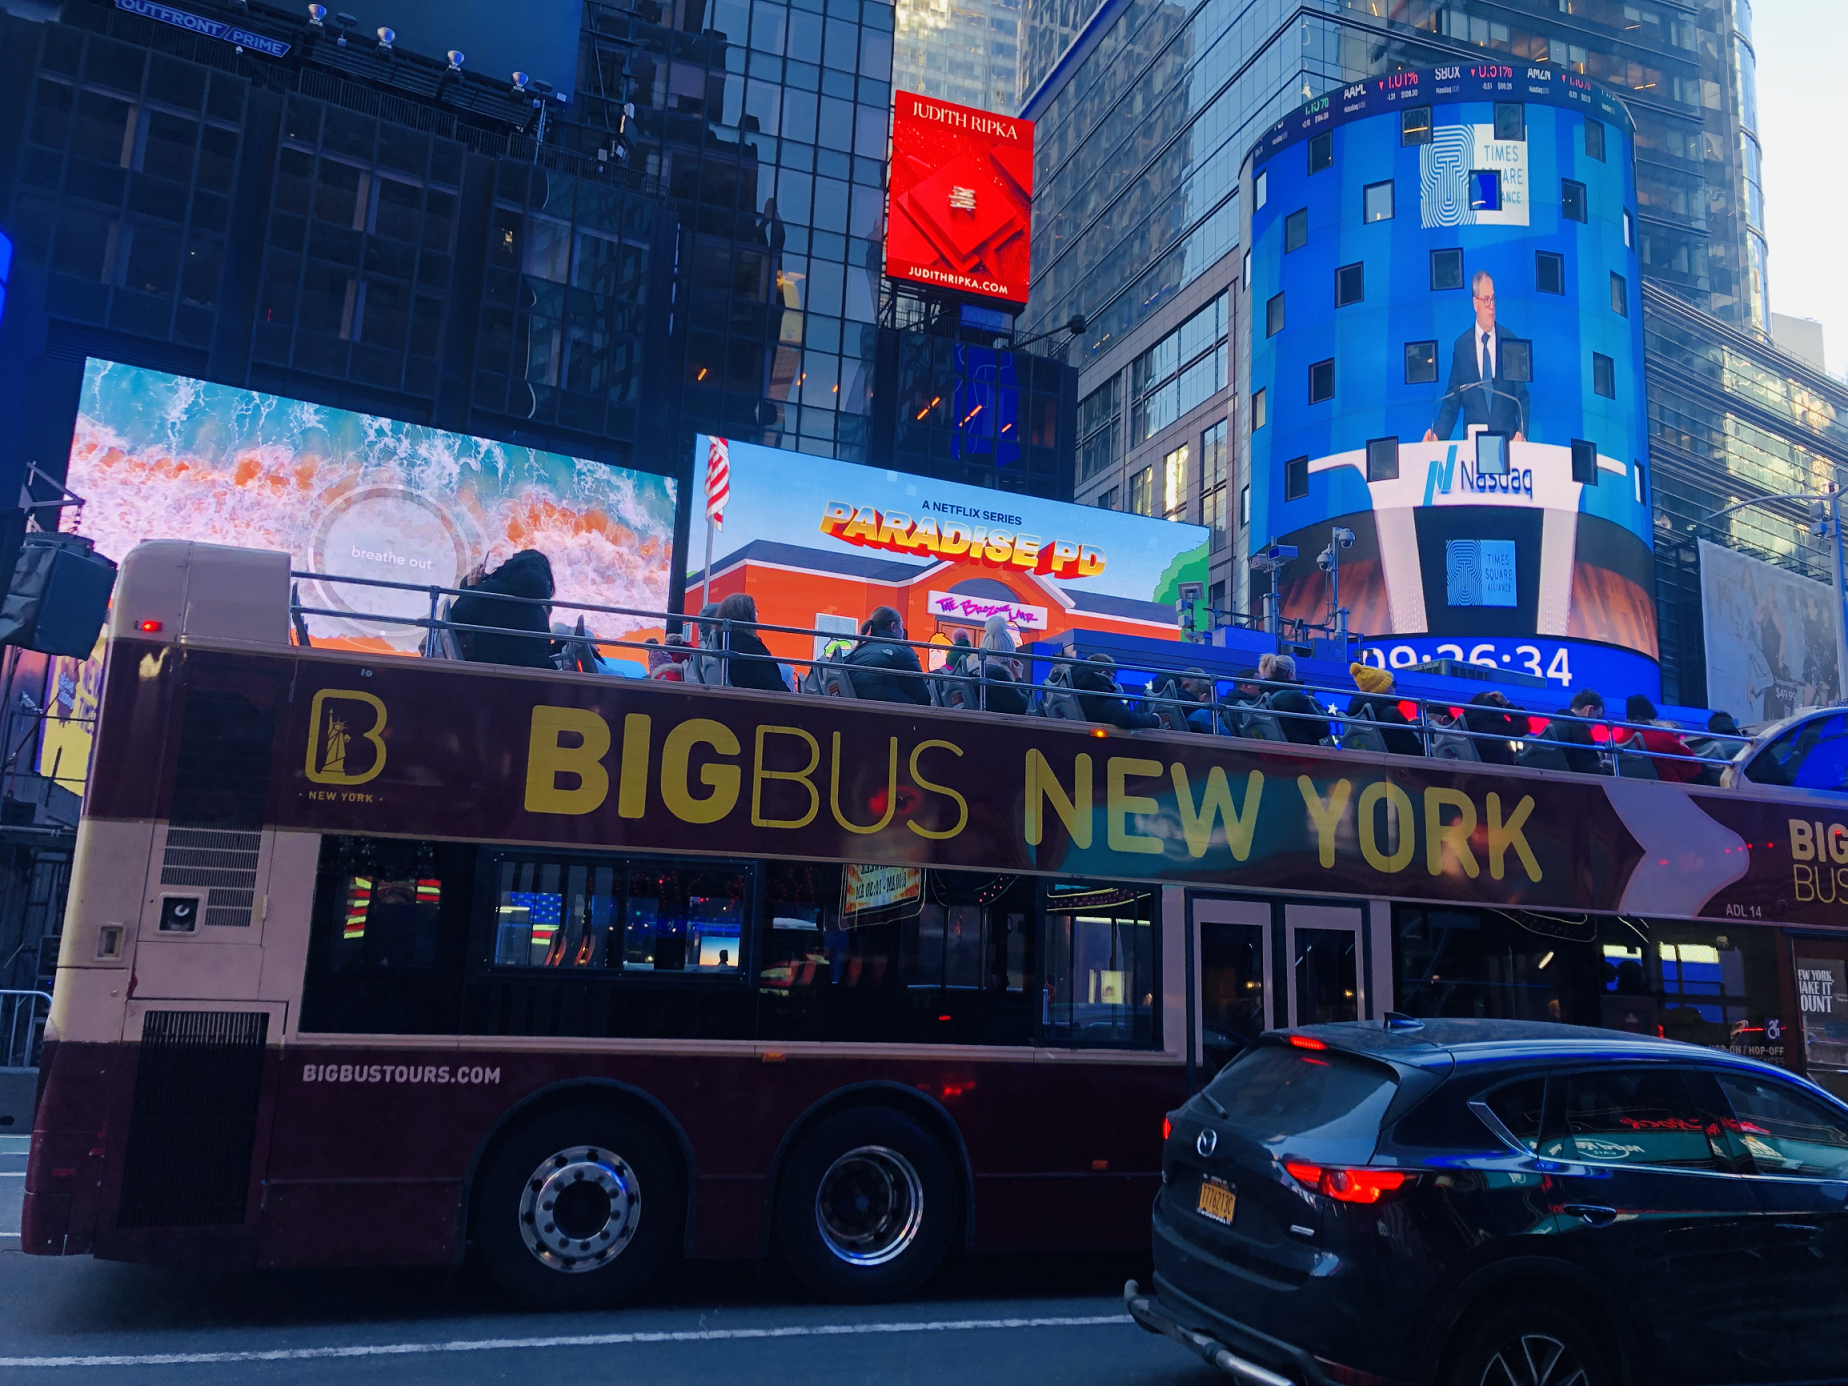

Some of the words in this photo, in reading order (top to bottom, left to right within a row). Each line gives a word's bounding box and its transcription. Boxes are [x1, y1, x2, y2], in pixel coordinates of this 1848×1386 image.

[122, 0, 222, 36] OUTFRONT
[233, 31, 283, 54] PRIME
[1344, 83, 1366, 100] AAPL
[1435, 66, 1460, 81] SBUX
[913, 101, 967, 128] JUDITH
[971, 115, 1018, 140] RIPKA
[1484, 145, 1519, 162] TIMES
[908, 266, 1008, 295] JUDITHRIPKA.COM
[922, 500, 930, 510] A
[932, 502, 980, 519] NETFLIX
[983, 510, 1022, 526] SERIES
[819, 500, 1042, 571] PARADISE
[1051, 539, 1108, 578] PD
[351, 545, 405, 565] breathe
[409, 558, 432, 570] out
[1487, 553, 1510, 566] TIMES
[1485, 568, 1512, 582] SQUARE
[1775, 687, 1797, 701] $49.99
[308, 790, 337, 801] NEW
[341, 792, 374, 803] YORK
[1024, 748, 1265, 861] NEW
[1297, 774, 1543, 882] YORK
[1788, 818, 1848, 864] BIG
[1793, 863, 1848, 905] BUS
[1726, 903, 1747, 917] ADL
[1749, 905, 1762, 918] 14
[1797, 969, 1810, 980] EW
[1822, 982, 1833, 995] IT
[1800, 994, 1833, 1012] OUNT
[1749, 1046, 1784, 1055] HOP-OFF
[303, 1064, 500, 1084] BIGBUSTOURS.COM
